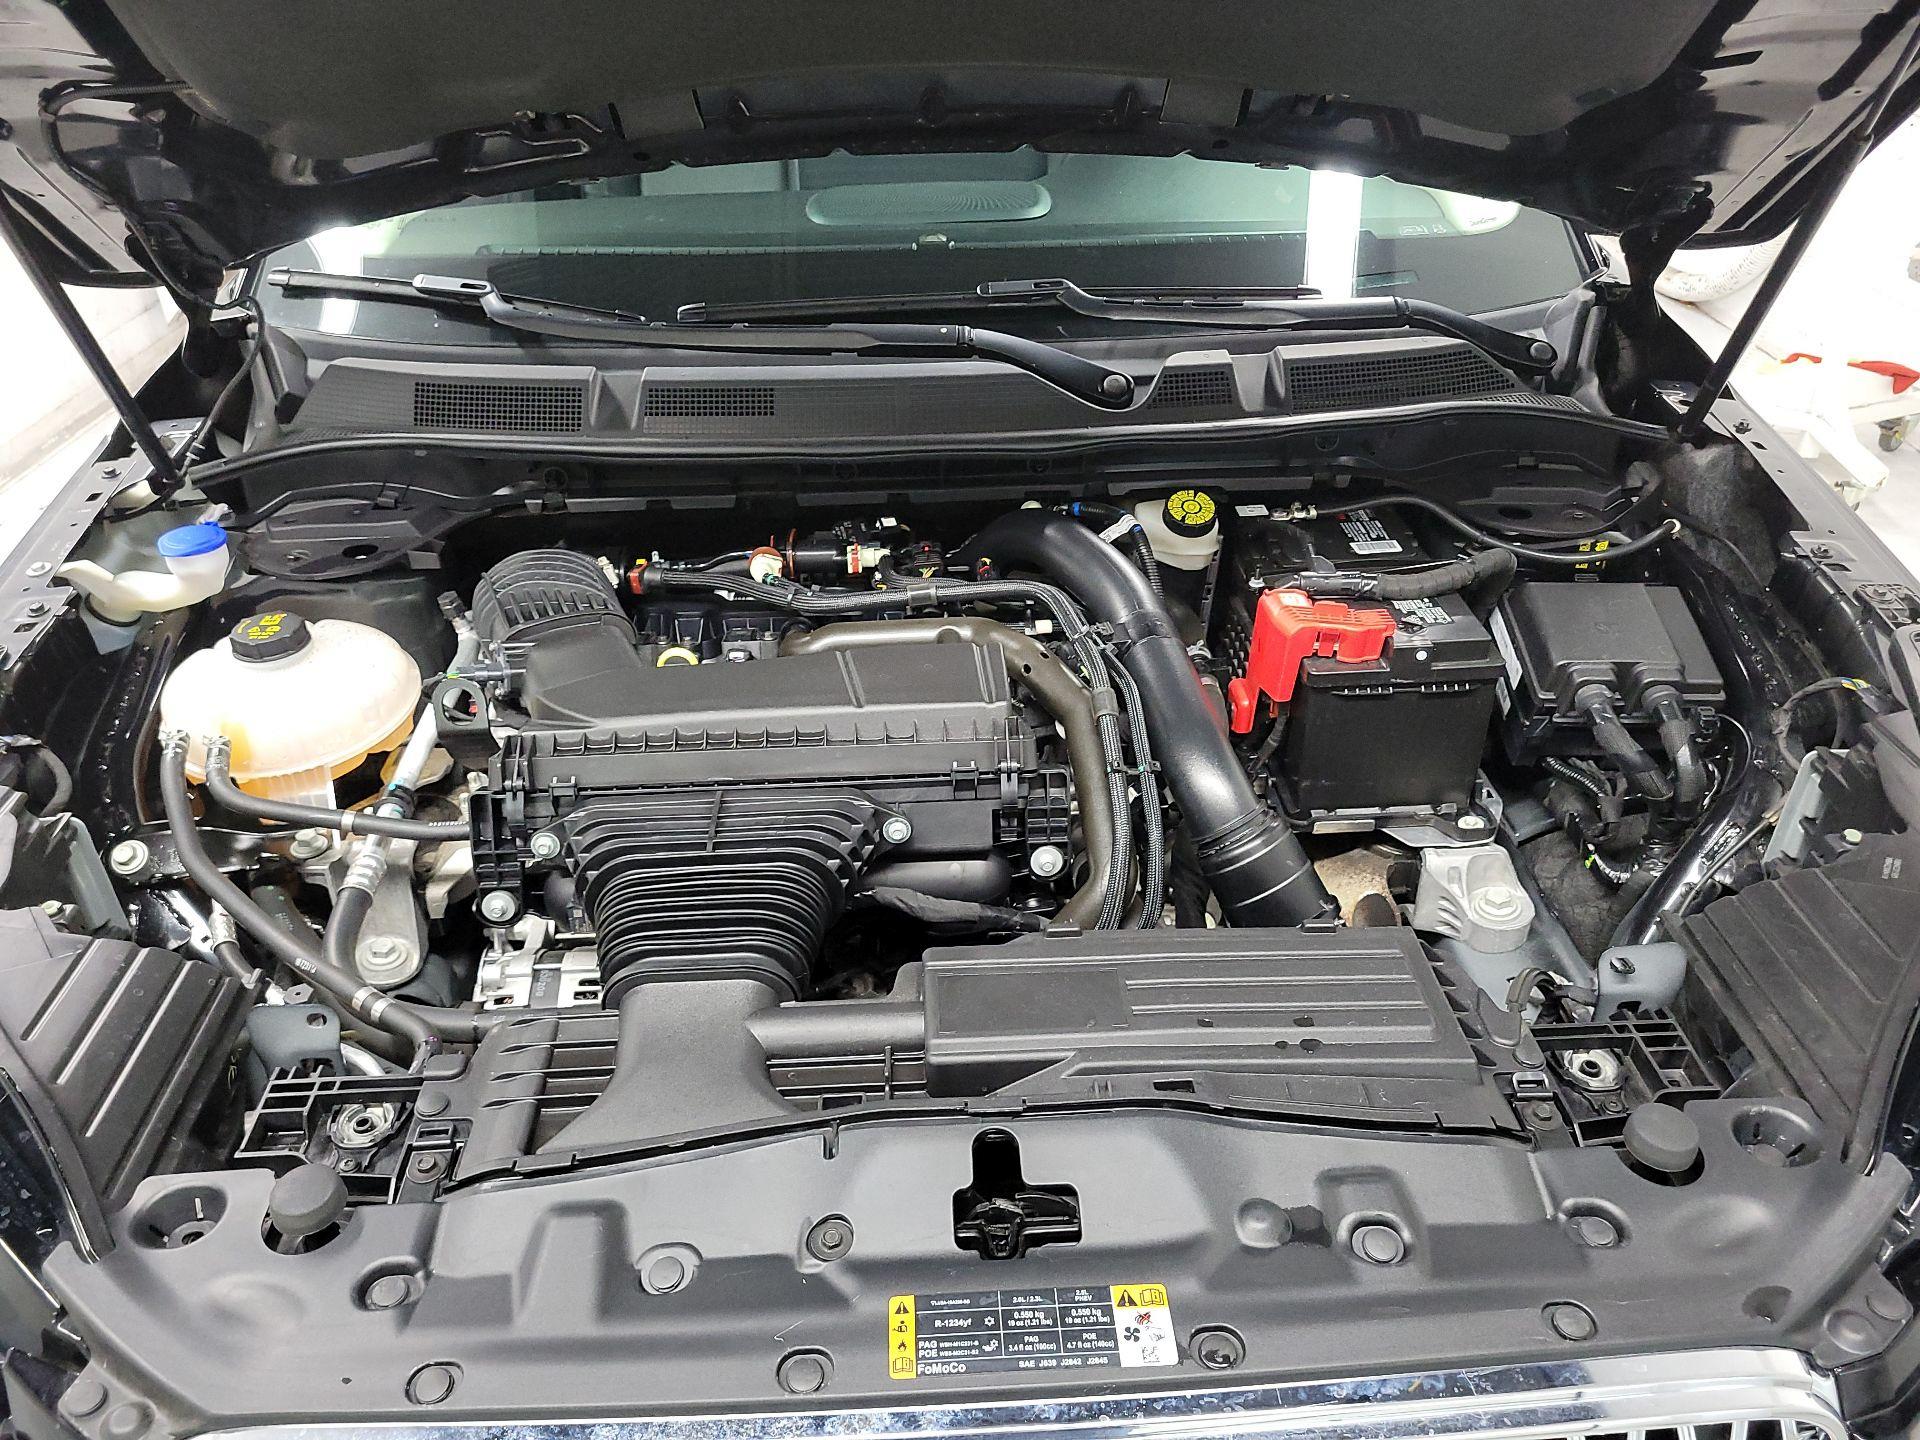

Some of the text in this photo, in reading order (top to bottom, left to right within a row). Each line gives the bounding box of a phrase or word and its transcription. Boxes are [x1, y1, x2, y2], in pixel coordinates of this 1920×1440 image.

[1014, 1310, 1045, 1319] 0.550 kg
[1071, 1308, 1102, 1317] 0.550 kg
[934, 1318, 972, 1327] R-1234yf
[1023, 1335, 1040, 1343] PAG
[1082, 1332, 1098, 1340] POE
[918, 1340, 938, 1349] PAG
[1008, 1344, 1019, 1352] 3.4
[918, 1348, 939, 1358] POE
[917, 1362, 966, 1374] FoMoCo
[1018, 1359, 1036, 1368] SAE
